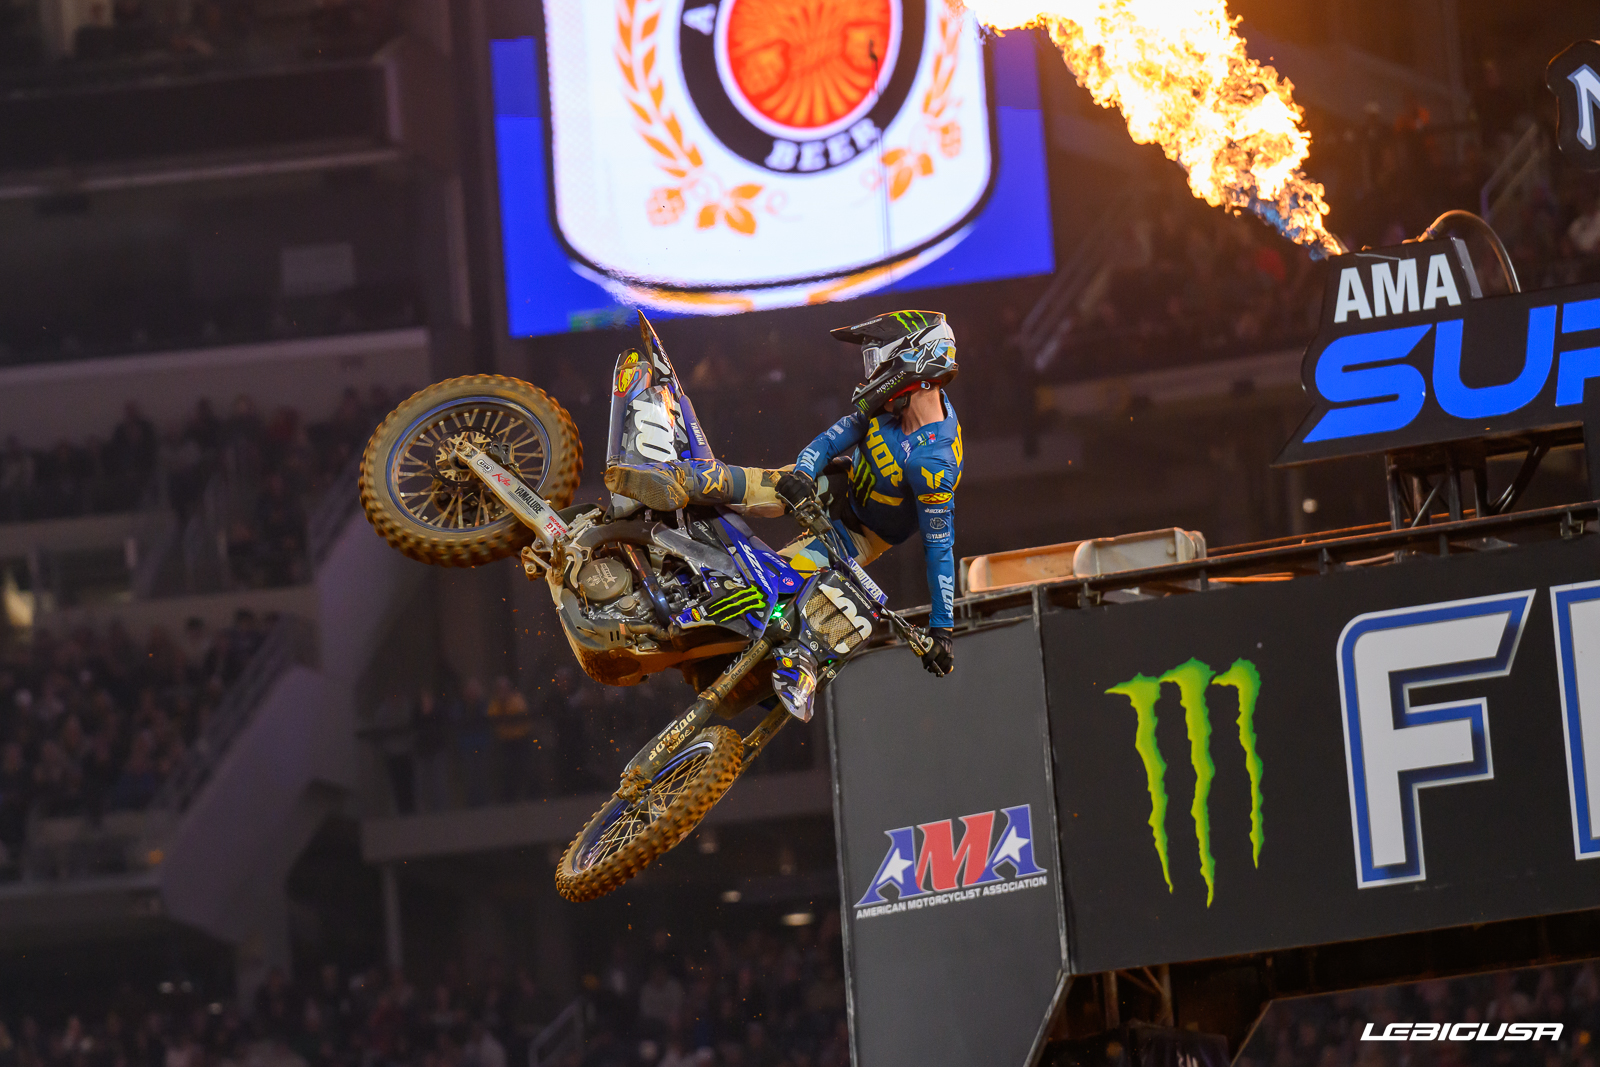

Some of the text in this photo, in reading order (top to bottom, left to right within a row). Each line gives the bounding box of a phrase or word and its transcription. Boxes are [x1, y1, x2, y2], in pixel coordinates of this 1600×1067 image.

[764, 117, 879, 172] BEER
[1333, 253, 1462, 324] AMA
[690, 422, 706, 446] YAMAHA
[513, 485, 546, 515] YAMALUBE
[730, 656, 752, 681] racing
[853, 803, 1048, 908] AMA
[855, 875, 1048, 920] AMERICAN MOTORCYCLIST ASSOCIATION
